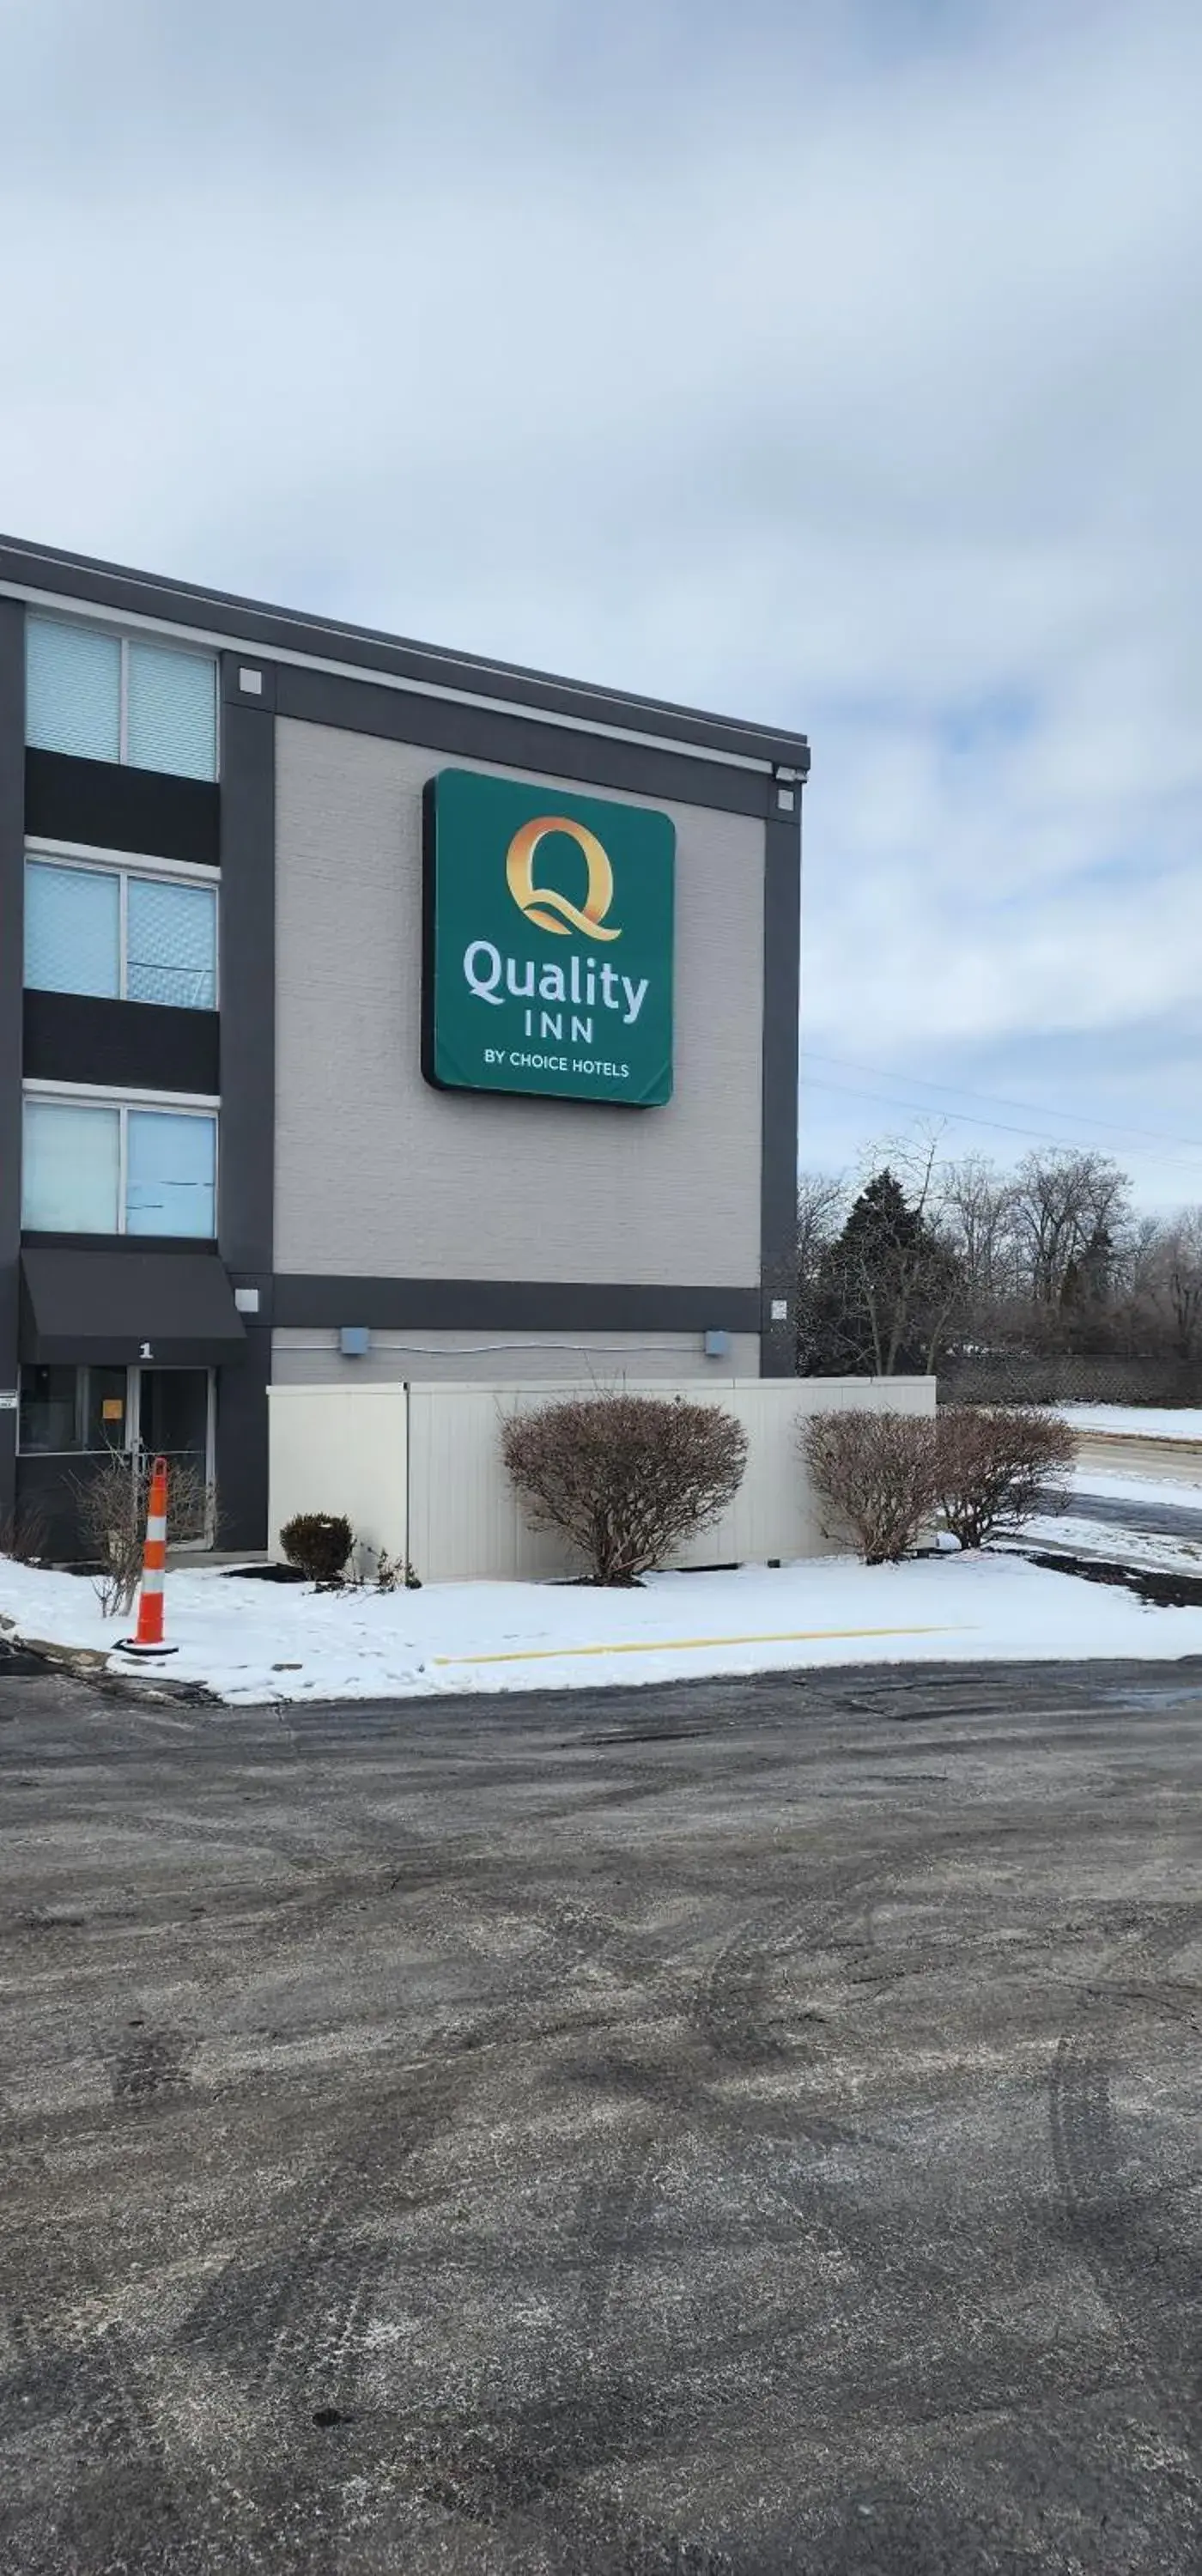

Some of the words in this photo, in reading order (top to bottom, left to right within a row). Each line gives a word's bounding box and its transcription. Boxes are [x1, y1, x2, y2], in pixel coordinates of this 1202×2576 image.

[507, 816, 622, 941] Q
[464, 940, 650, 1024] Quality
[525, 1010, 592, 1043] INN
[484, 1049, 505, 1063] BY
[509, 1052, 568, 1071] CHOICE
[573, 1059, 629, 1078] HOTELS
[139, 1342, 153, 1359] 1
